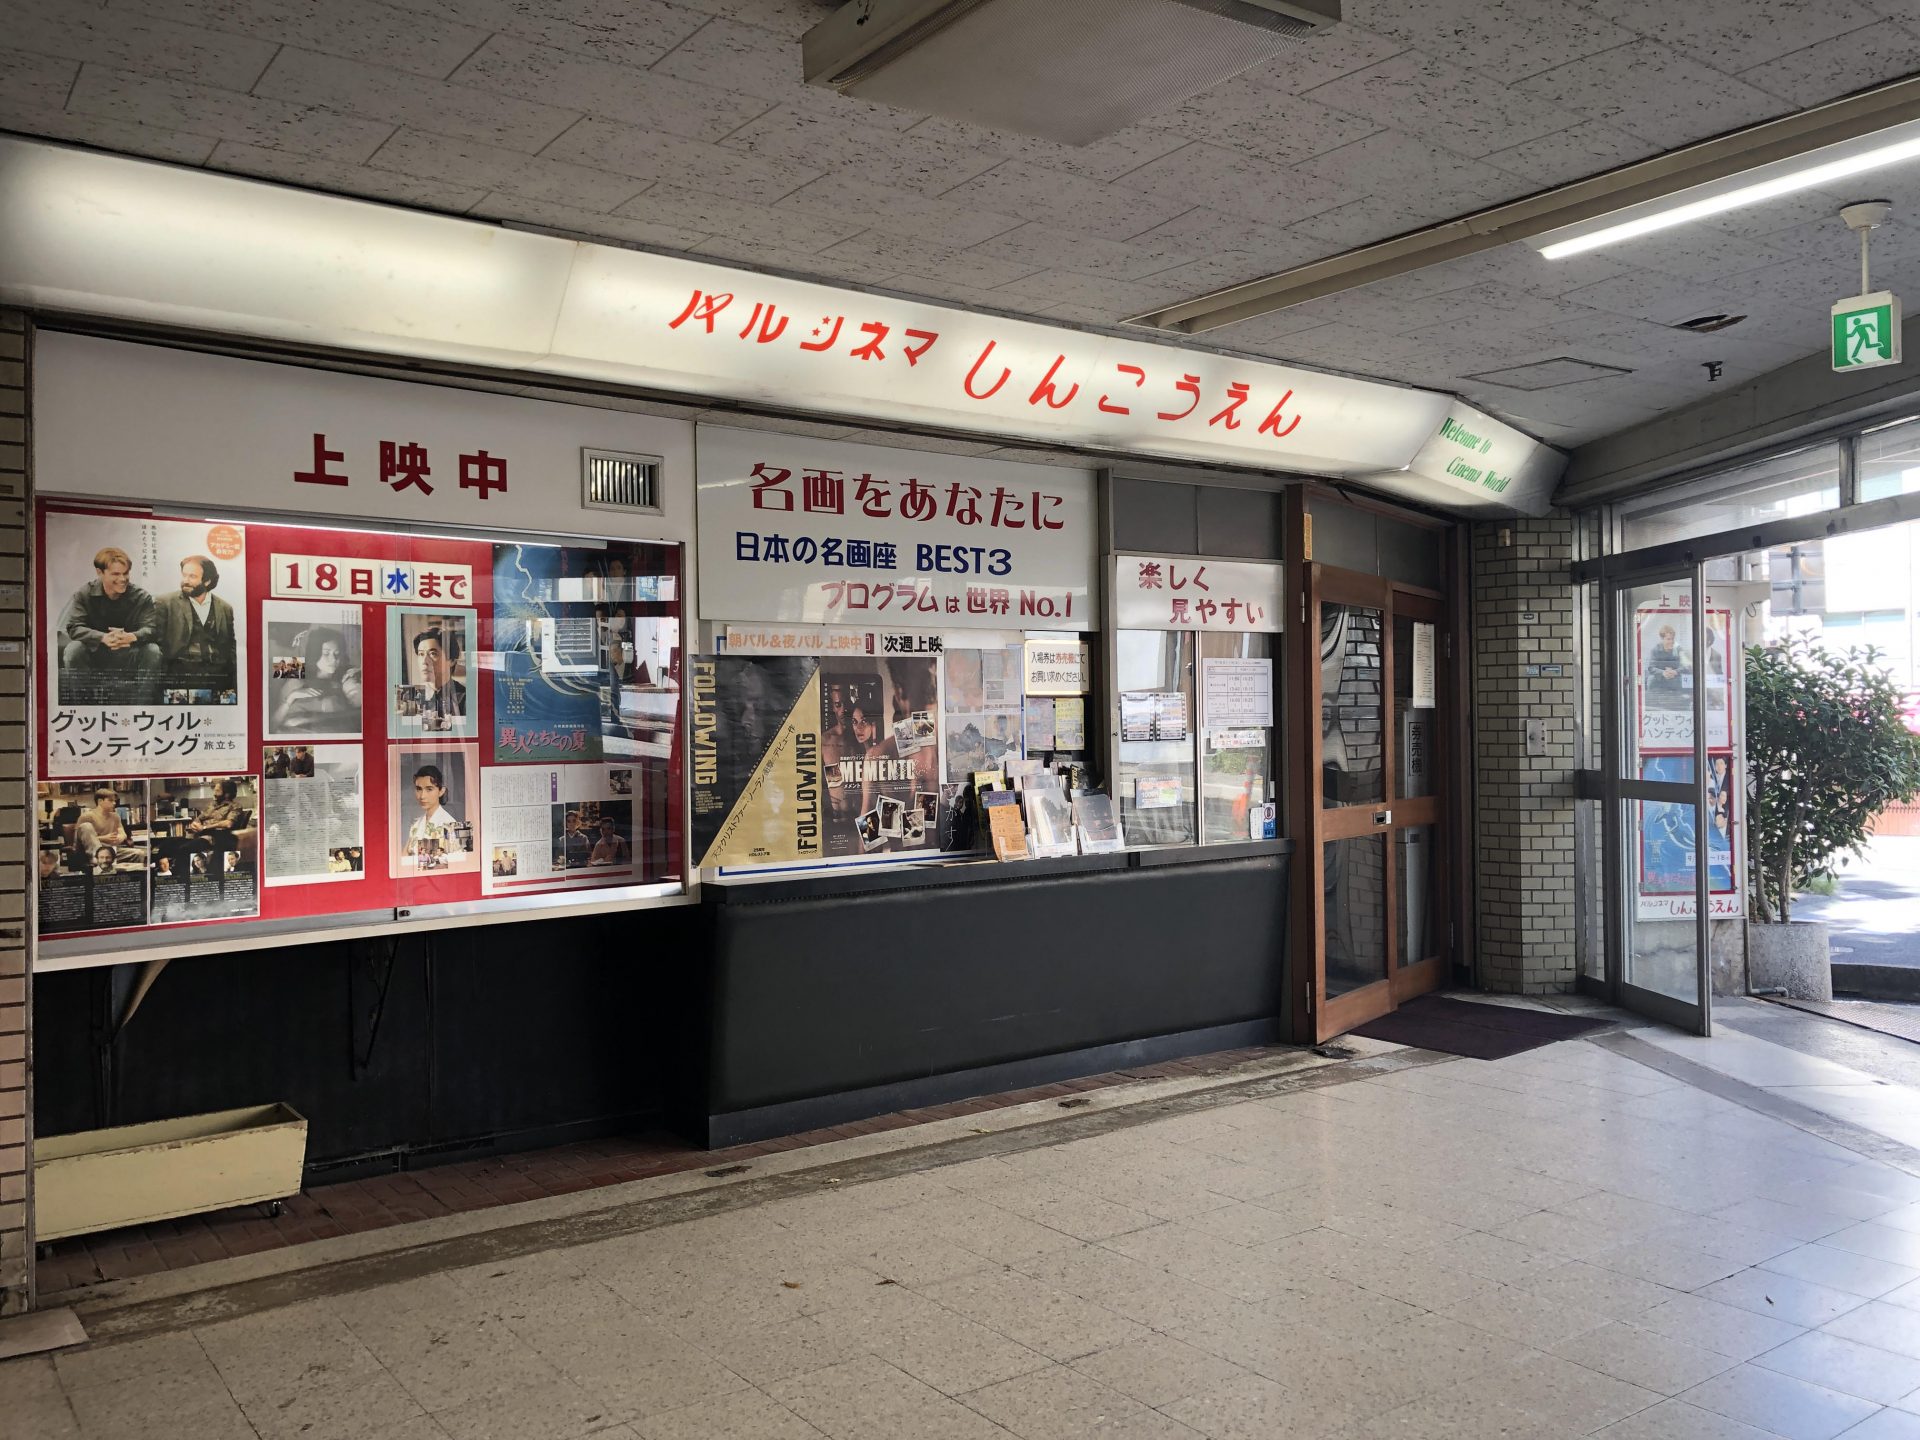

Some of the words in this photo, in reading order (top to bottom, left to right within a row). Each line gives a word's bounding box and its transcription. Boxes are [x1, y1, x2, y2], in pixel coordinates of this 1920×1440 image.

[963, 339, 1302, 438] しんこうえん
[1439, 417, 1481, 449] Welcome
[1479, 439, 1493, 454] to
[294, 433, 509, 500] 上映中
[1446, 456, 1482, 482] Cinema
[1483, 470, 1511, 493] World
[749, 462, 1065, 531] 名画をあなたに
[735, 531, 898, 570] 日本の名画座
[915, 543, 1012, 576] BEST3
[1138, 561, 1210, 592] 楽しく
[1019, 589, 1073, 619] No.1
[1169, 597, 1265, 625] 見やすい
[883, 634, 943, 654] 次週上映
[50, 709, 119, 732] グッド
[133, 710, 202, 732] ウィル
[694, 662, 717, 785] FOLLOWING
[203, 740, 237, 751] 旅立ち
[499, 725, 589, 755] 異人たちとの夏
[1411, 724, 1423, 774] 券売機
[839, 759, 917, 784] MEMENTO
[796, 732, 818, 851] FOLLOWING
